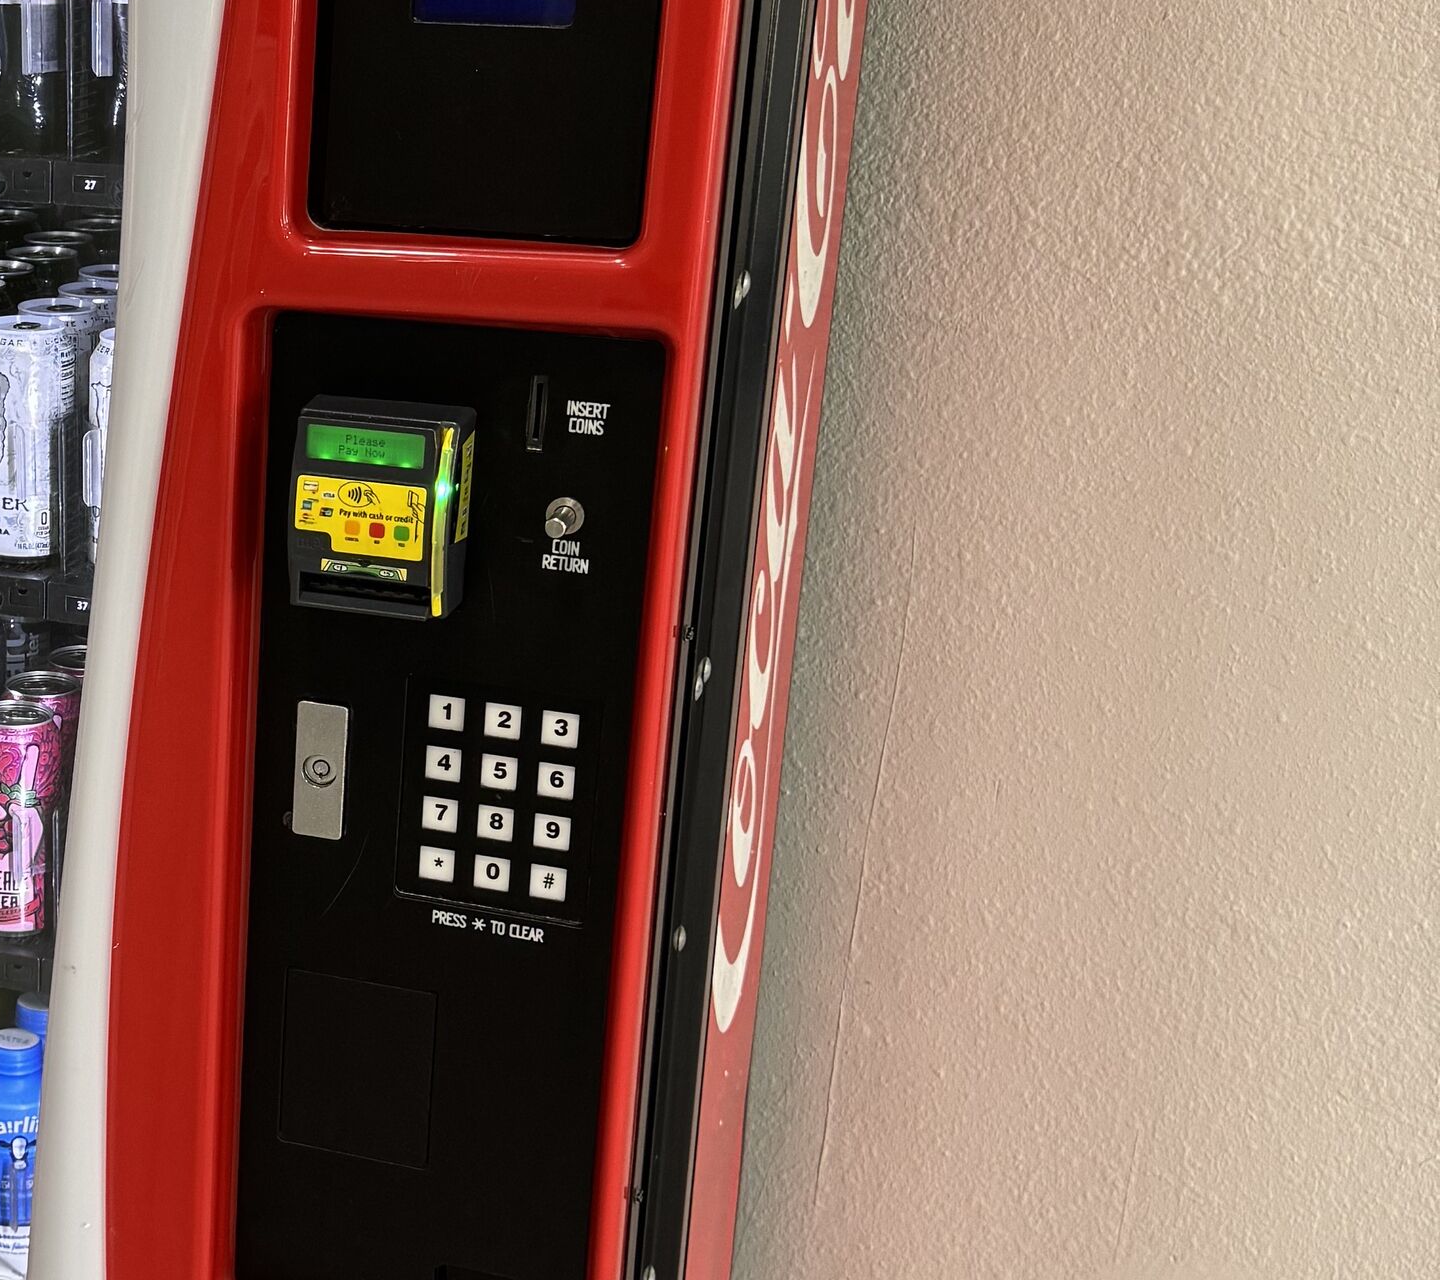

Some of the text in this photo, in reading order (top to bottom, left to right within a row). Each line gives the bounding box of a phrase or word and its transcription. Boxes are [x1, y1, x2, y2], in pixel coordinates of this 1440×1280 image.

[84, 179, 97, 190] 27
[566, 399, 611, 420] INSERT
[568, 417, 605, 436] COINS
[345, 434, 386, 448] Please
[338, 444, 386, 458] Pay Now
[339, 508, 352, 519] Pay
[352, 510, 368, 519] with
[368, 512, 384, 520] cash
[393, 514, 414, 524] credit
[551, 538, 581, 557] COIN
[541, 554, 590, 575] RETURN
[76, 600, 89, 611] 37
[442, 702, 453, 721] 1
[497, 711, 512, 729] 2
[553, 718, 569, 737] 3
[437, 754, 452, 771] 4
[493, 762, 508, 780] 5
[550, 770, 565, 789] 6
[434, 803, 449, 821] 7
[489, 812, 504, 831] 8
[545, 821, 561, 839] 9
[485, 862, 500, 880] 0
[431, 909, 545, 943] PRESS TO CLEAR
